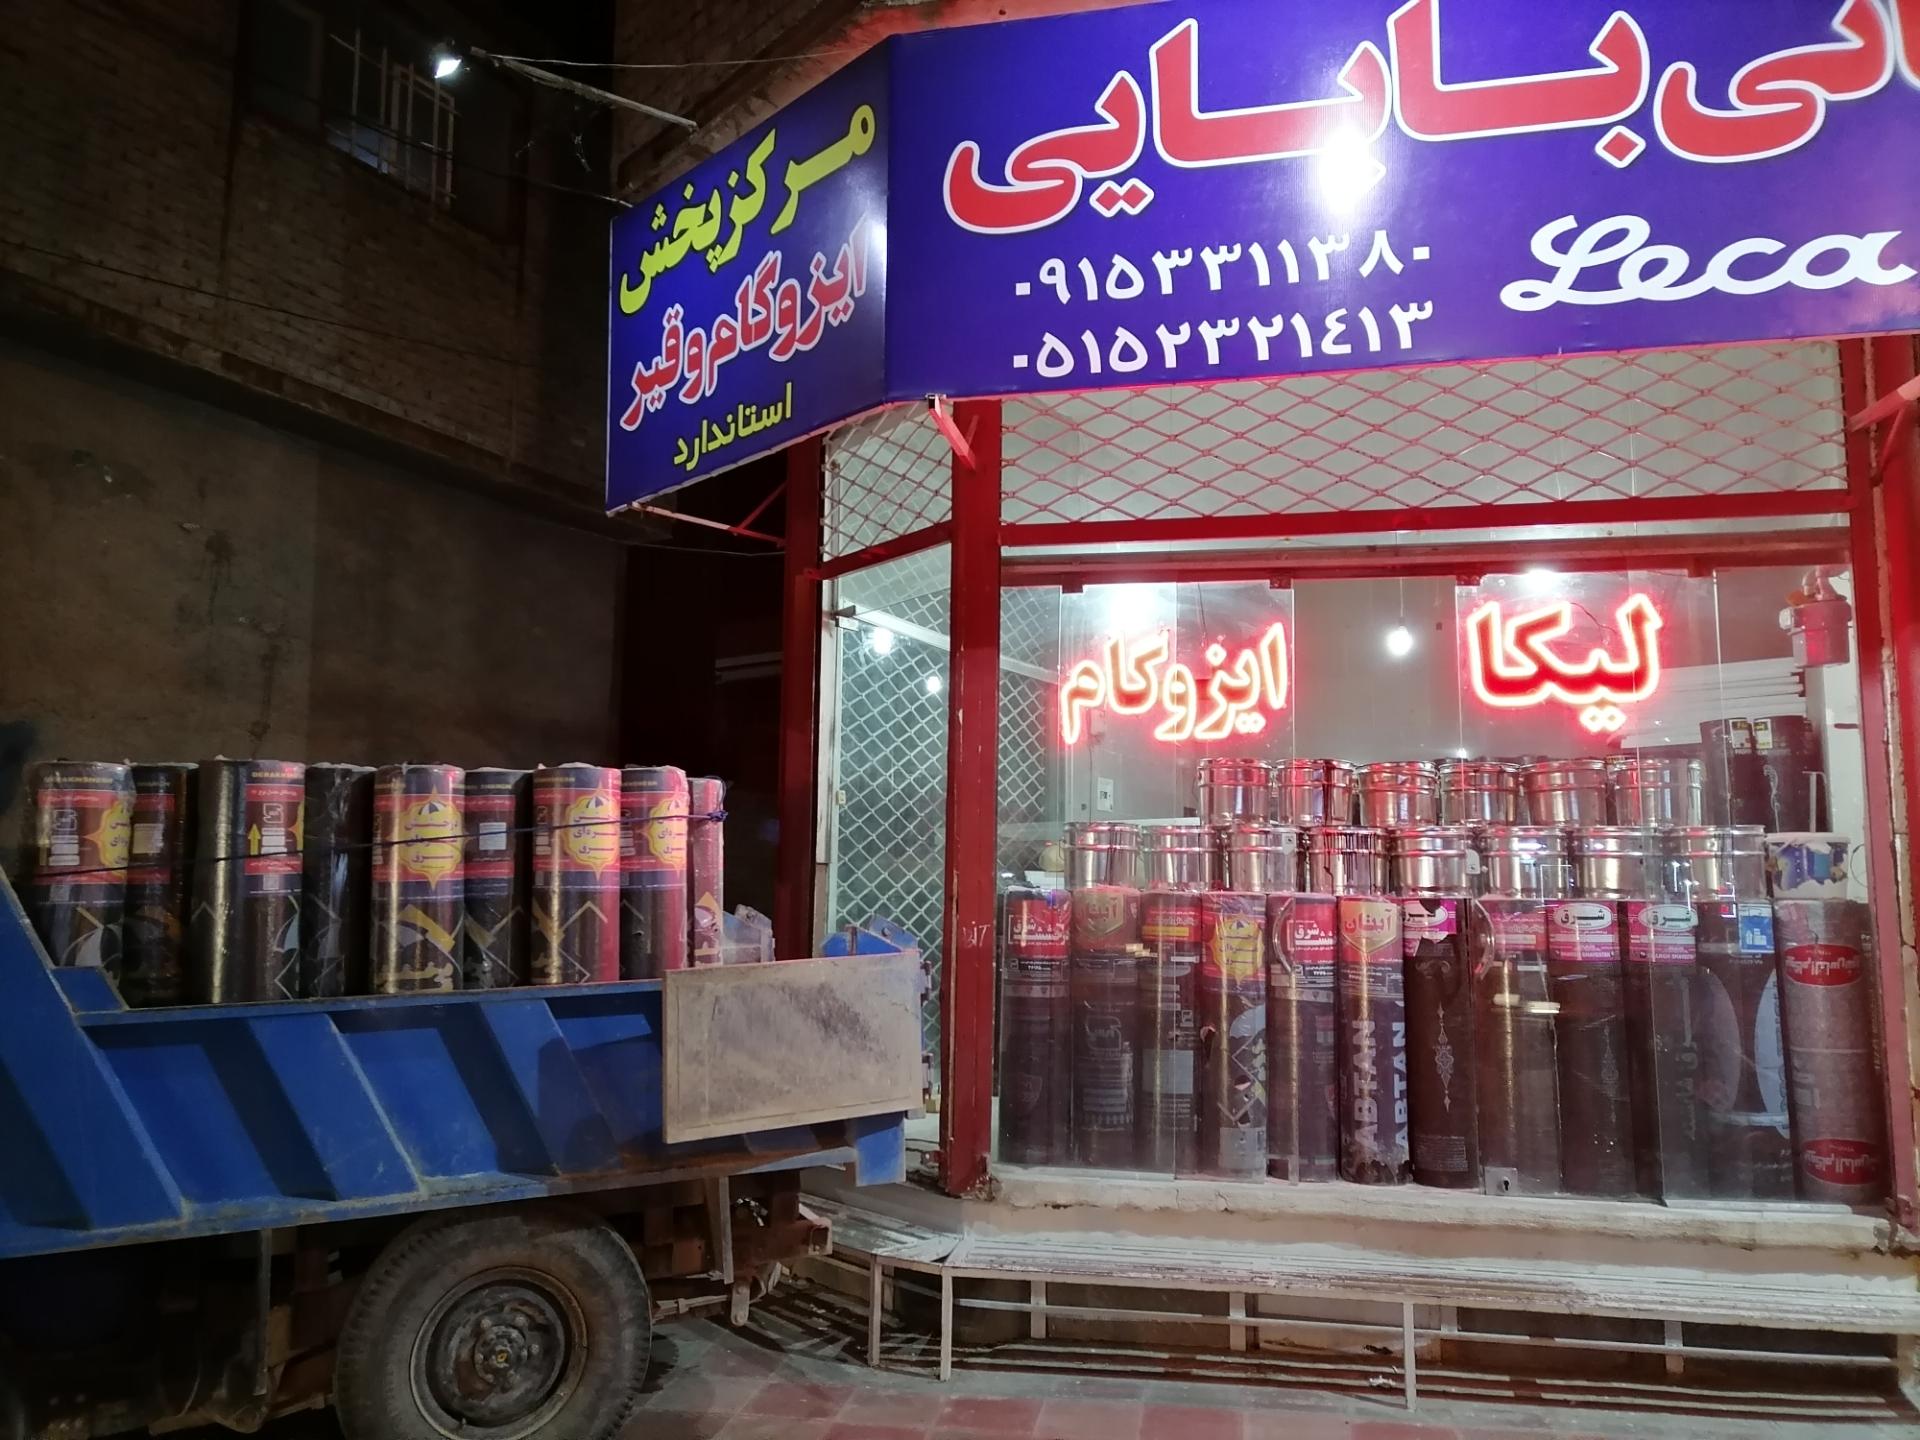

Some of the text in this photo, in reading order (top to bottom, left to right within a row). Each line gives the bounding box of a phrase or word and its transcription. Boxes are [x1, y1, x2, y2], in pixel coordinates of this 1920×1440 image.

[943, 0, 1650, 236] بابایی
[619, 103, 877, 314] مرکز پخش
[1500, 214, 1919, 312] Leca
[672, 382, 793, 472] استاندارد
[1352, 1020, 1378, 1148] ABTAN
